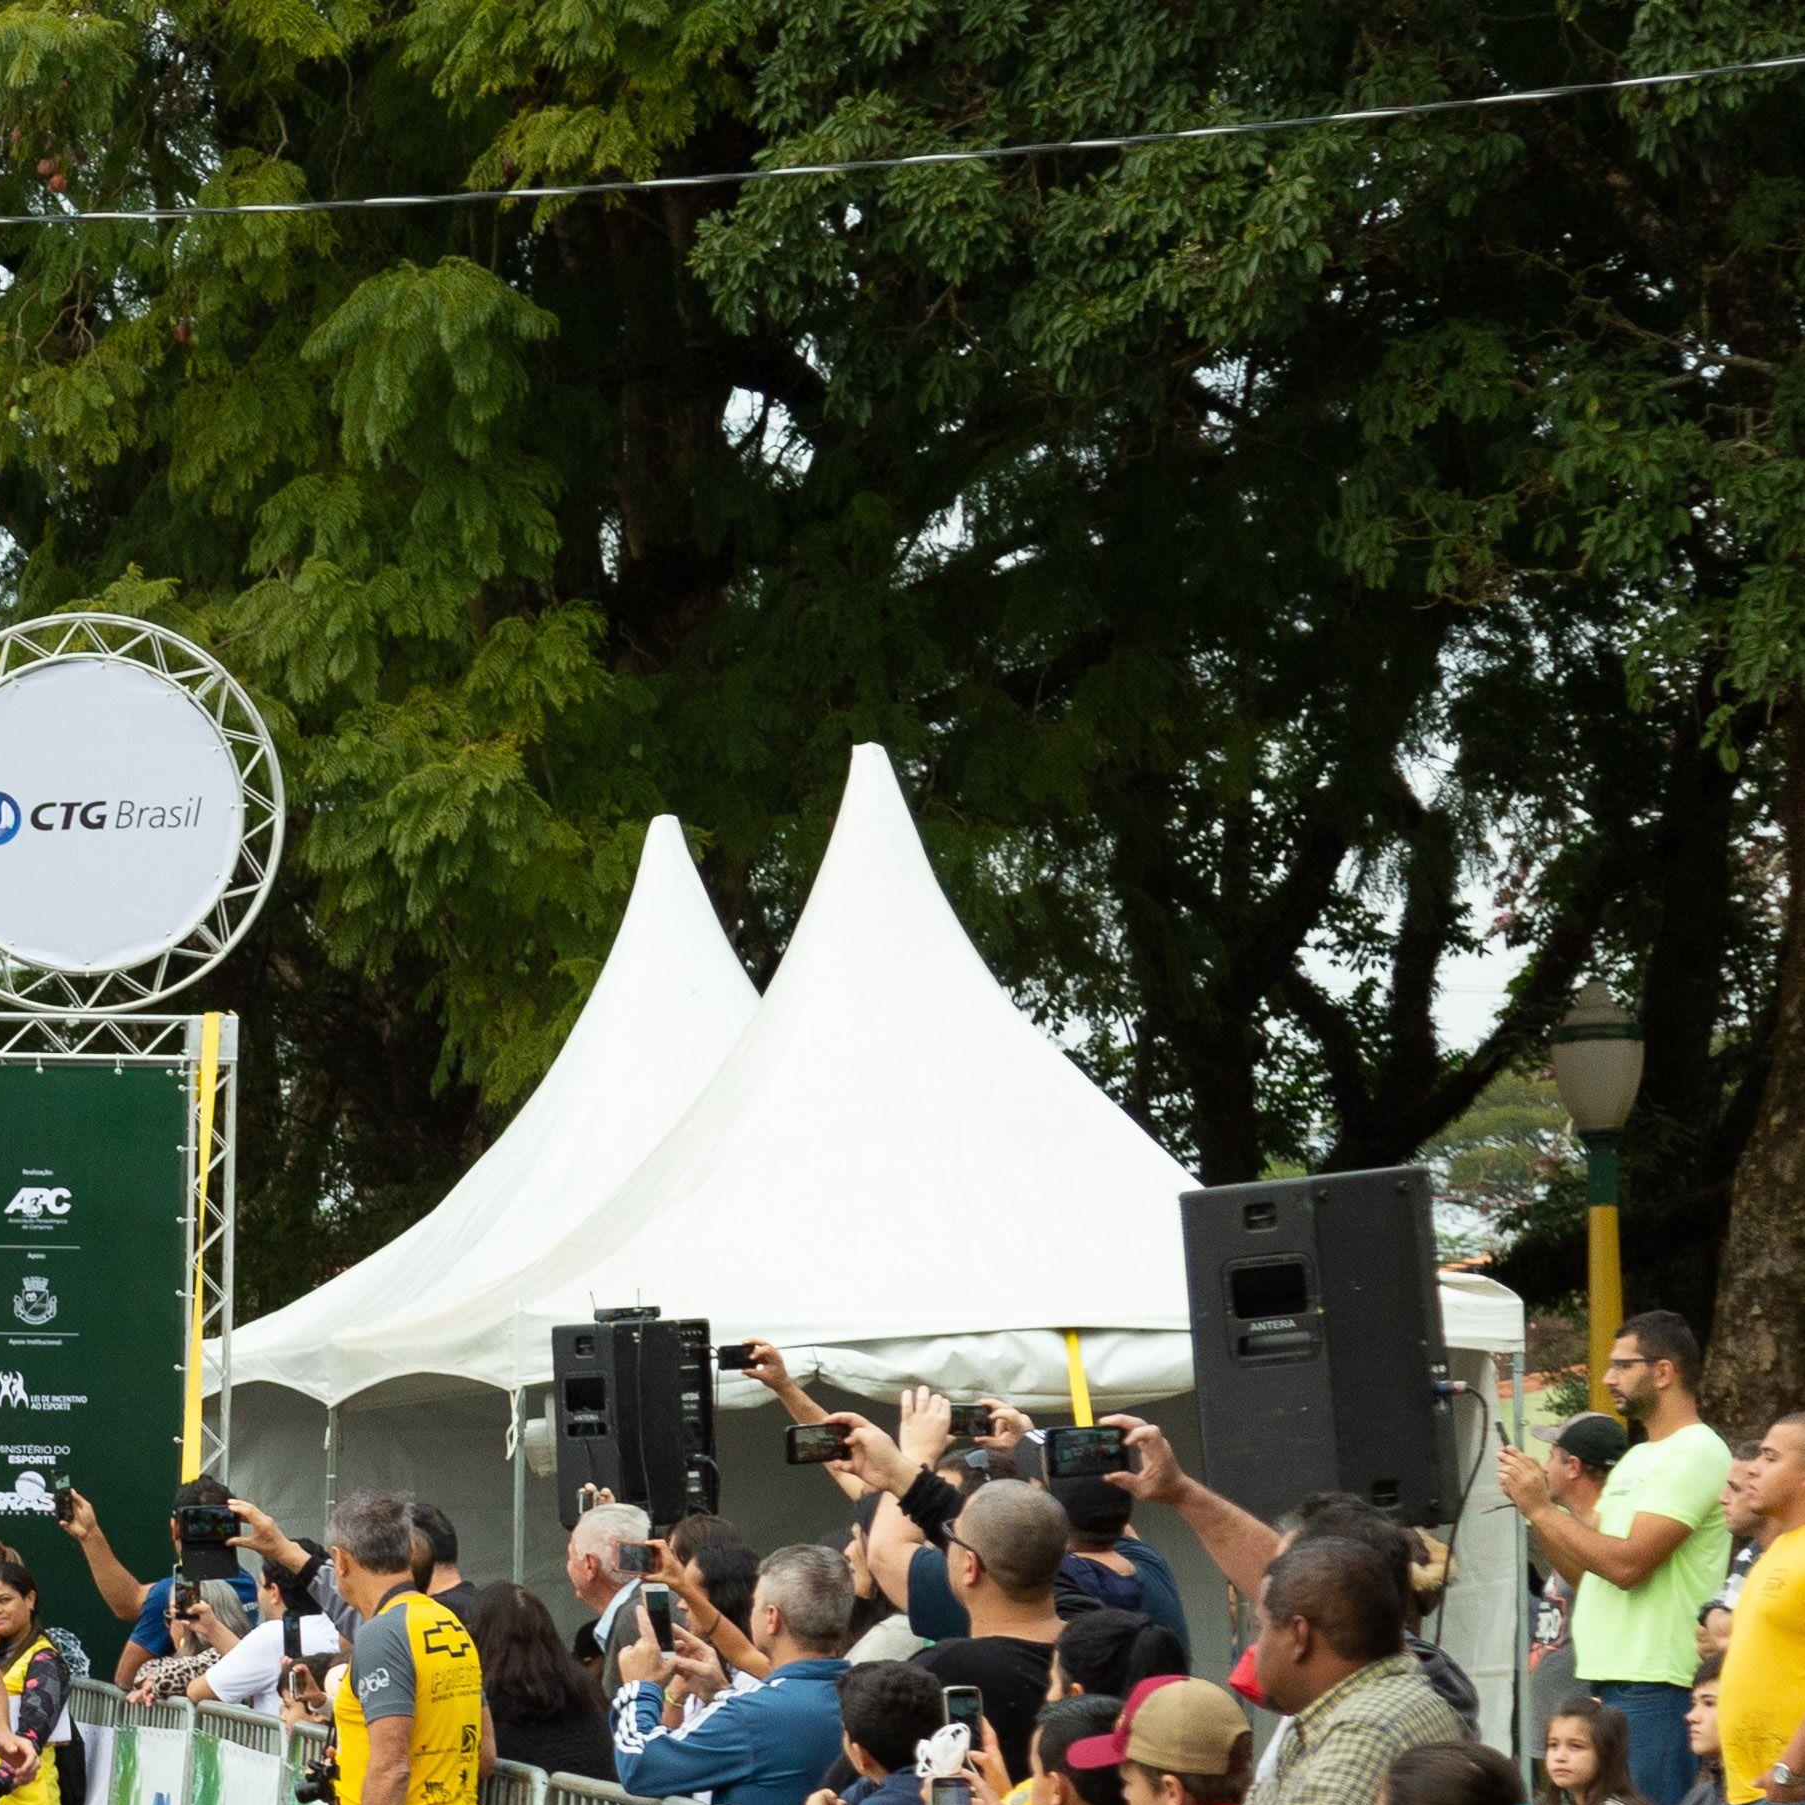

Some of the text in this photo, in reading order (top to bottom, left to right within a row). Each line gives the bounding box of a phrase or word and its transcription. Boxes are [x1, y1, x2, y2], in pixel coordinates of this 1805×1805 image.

[30, 797, 202, 831] CTG Brasil
[1249, 1319, 1296, 1332] ANTERA
[54, 1445, 70, 1455] DO
[8, 1455, 56, 1465] ESPORTE
